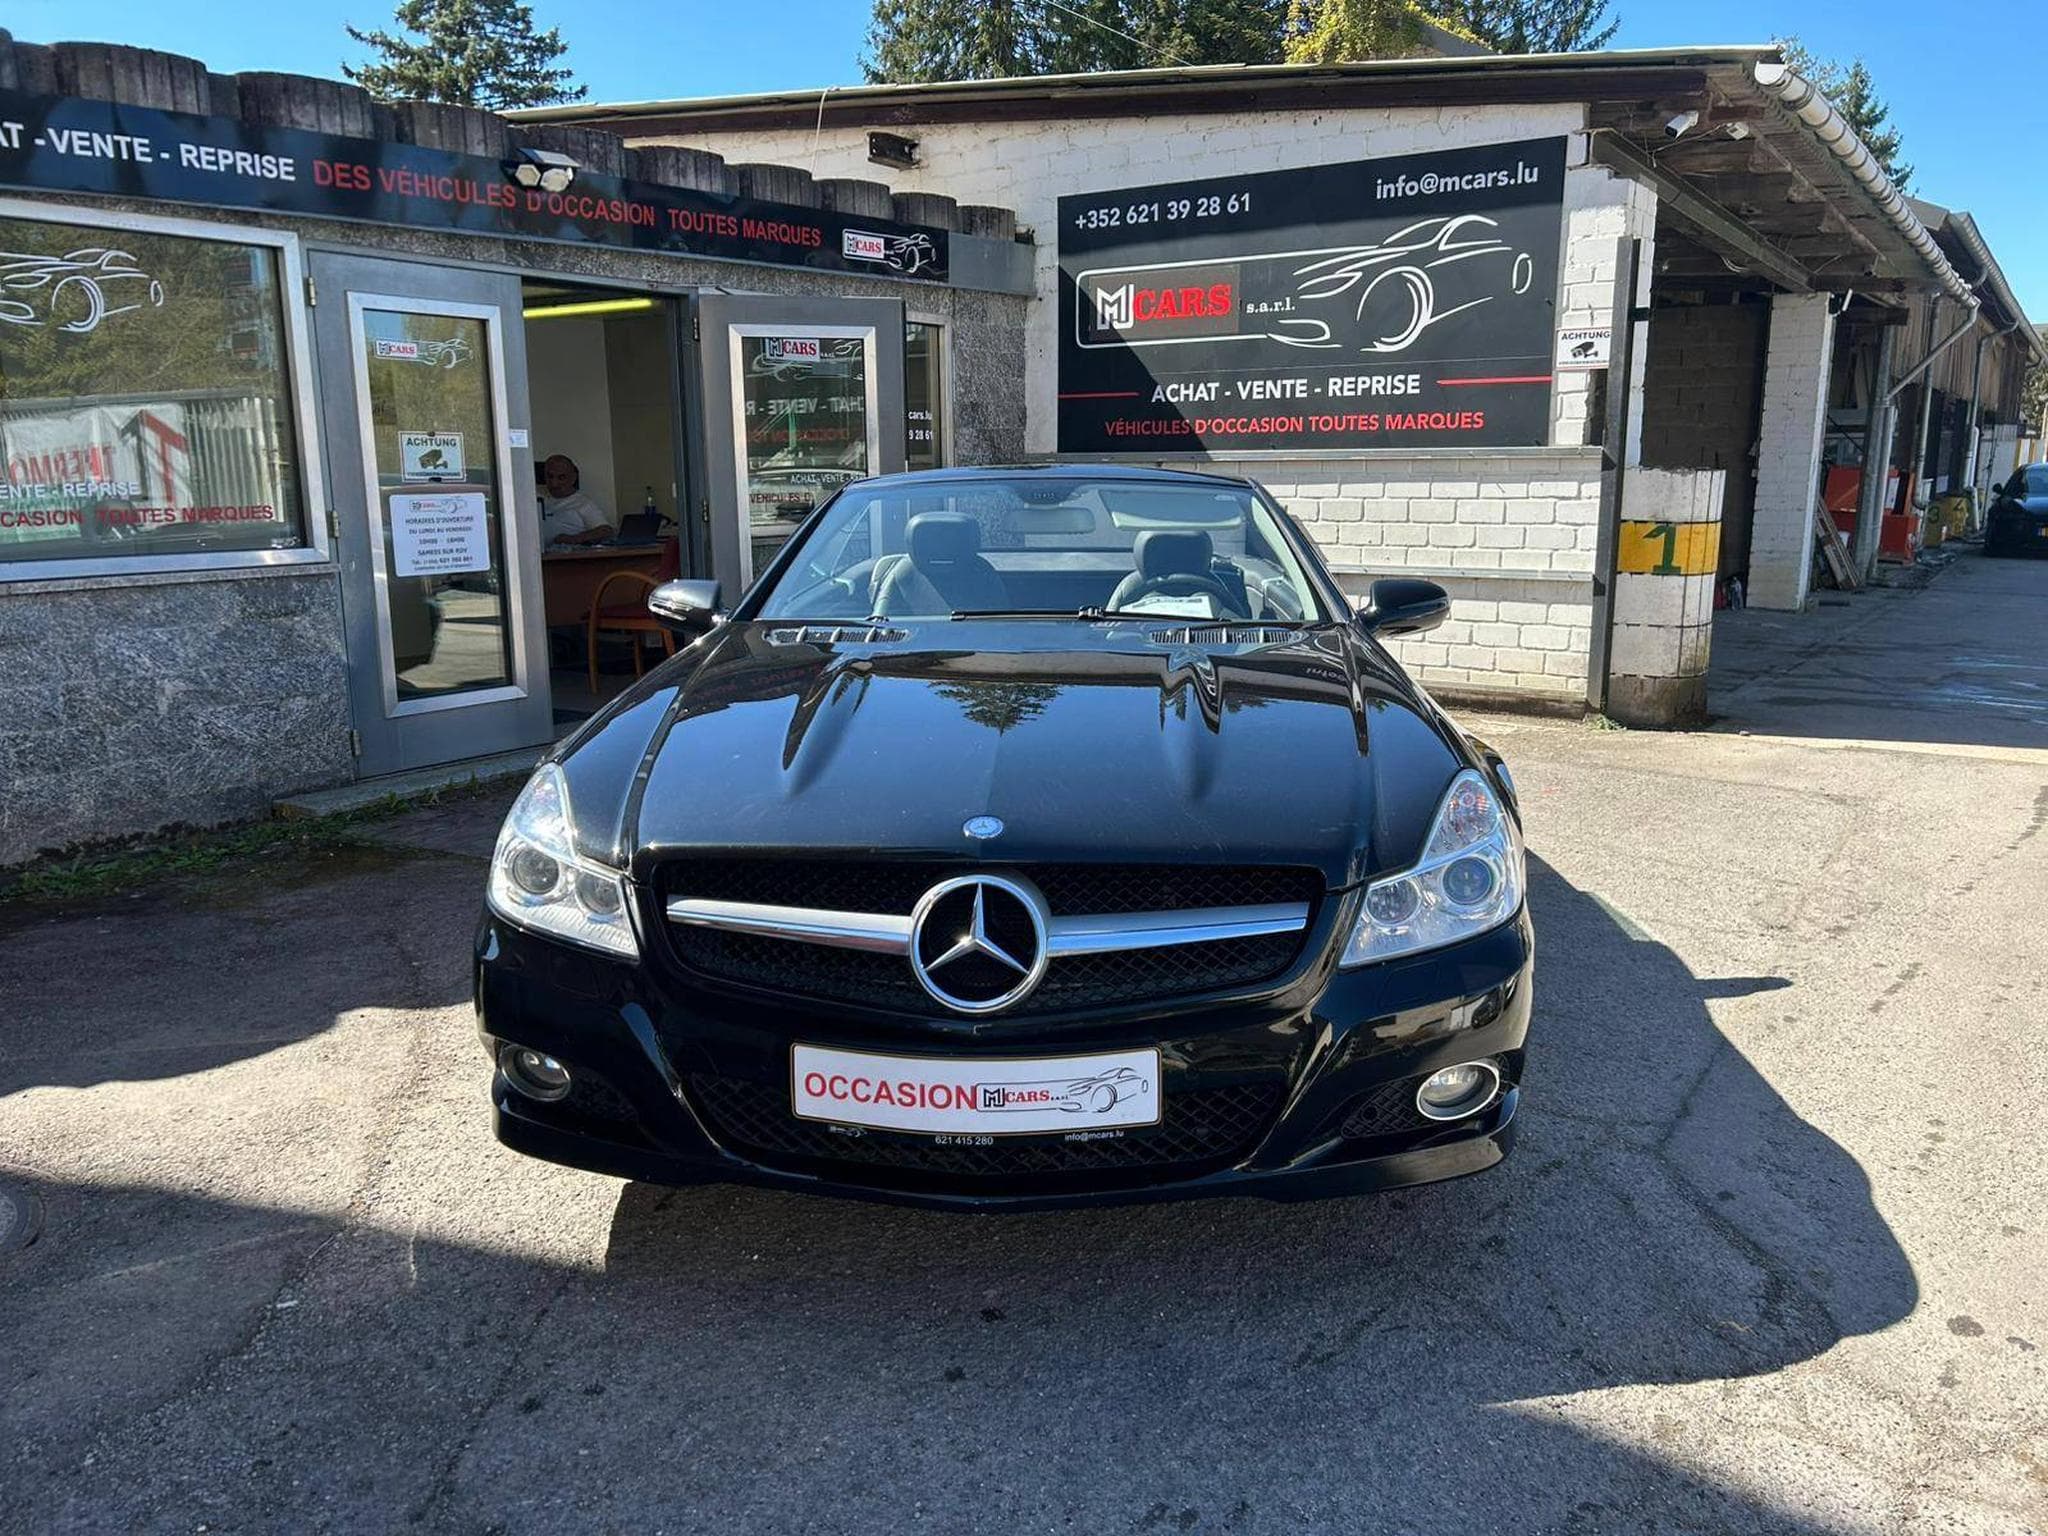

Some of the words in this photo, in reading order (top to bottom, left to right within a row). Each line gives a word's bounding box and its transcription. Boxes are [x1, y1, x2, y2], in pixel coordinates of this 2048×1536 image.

[1376, 161, 1539, 200] info@mcars.lu
[180, 143, 296, 181] REPRISE
[312, 160, 371, 190] DES
[377, 166, 516, 208] VÉHICULES
[526, 190, 655, 226] D'OCCASION
[667, 209, 738, 236] TOUTES
[742, 218, 822, 247] MARQUES
[1075, 208, 1121, 229] +352
[1126, 203, 1160, 224] 621
[1167, 200, 1191, 220] 39
[1197, 196, 1221, 217] 28
[1227, 193, 1250, 214] 61
[1246, 297, 1296, 314] s.a.r.l.
[1561, 330, 1610, 341] ACHTUNG
[1152, 382, 1220, 403] ACHAT
[1236, 378, 1308, 400] VENTE
[1328, 374, 1421, 398] REPRISE
[1105, 417, 1190, 436] VÉHICULES
[1195, 416, 1303, 435] D'OCCASION
[1309, 414, 1379, 432] TOUTES
[1385, 411, 1485, 430] MARQUES
[406, 436, 457, 447] ACHTUNG
[63, 481, 141, 498] REPRISE
[96, 508, 175, 525] TOUTES
[182, 506, 273, 523] MARQUES
[1643, 525, 1682, 575] 1
[804, 1072, 978, 1110] OCCASION
[935, 1136, 952, 1145] 621
[956, 1136, 973, 1145] 415
[975, 1136, 994, 1146] 280
[1065, 1129, 1124, 1142] info@mcars.lu
